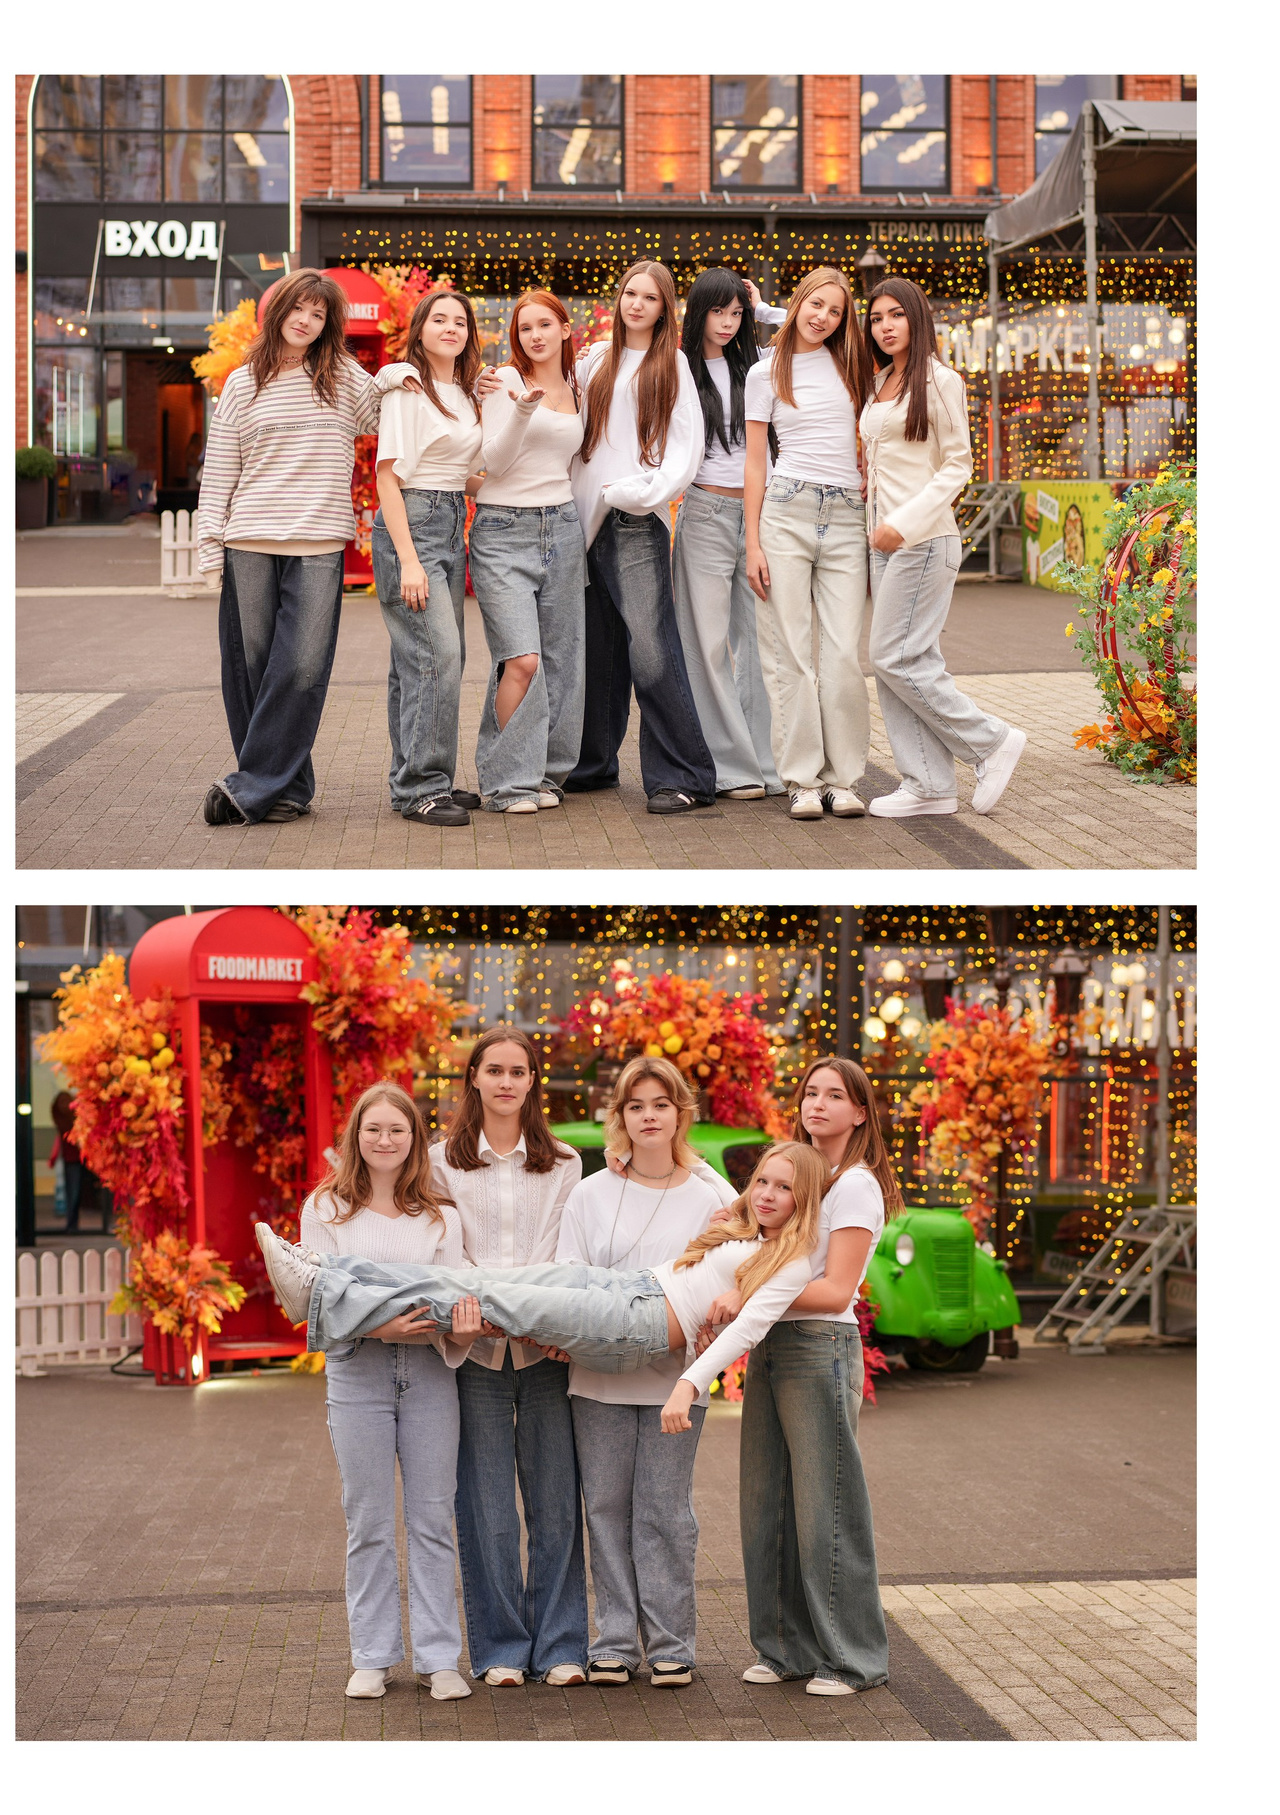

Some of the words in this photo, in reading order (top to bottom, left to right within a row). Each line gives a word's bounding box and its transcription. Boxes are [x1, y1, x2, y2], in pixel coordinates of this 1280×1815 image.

[105, 220, 219, 261] ВХОД
[868, 221, 940, 243] ТЕРРАСА
[346, 302, 380, 320] ARKET
[208, 955, 304, 982] FOODMARKET
